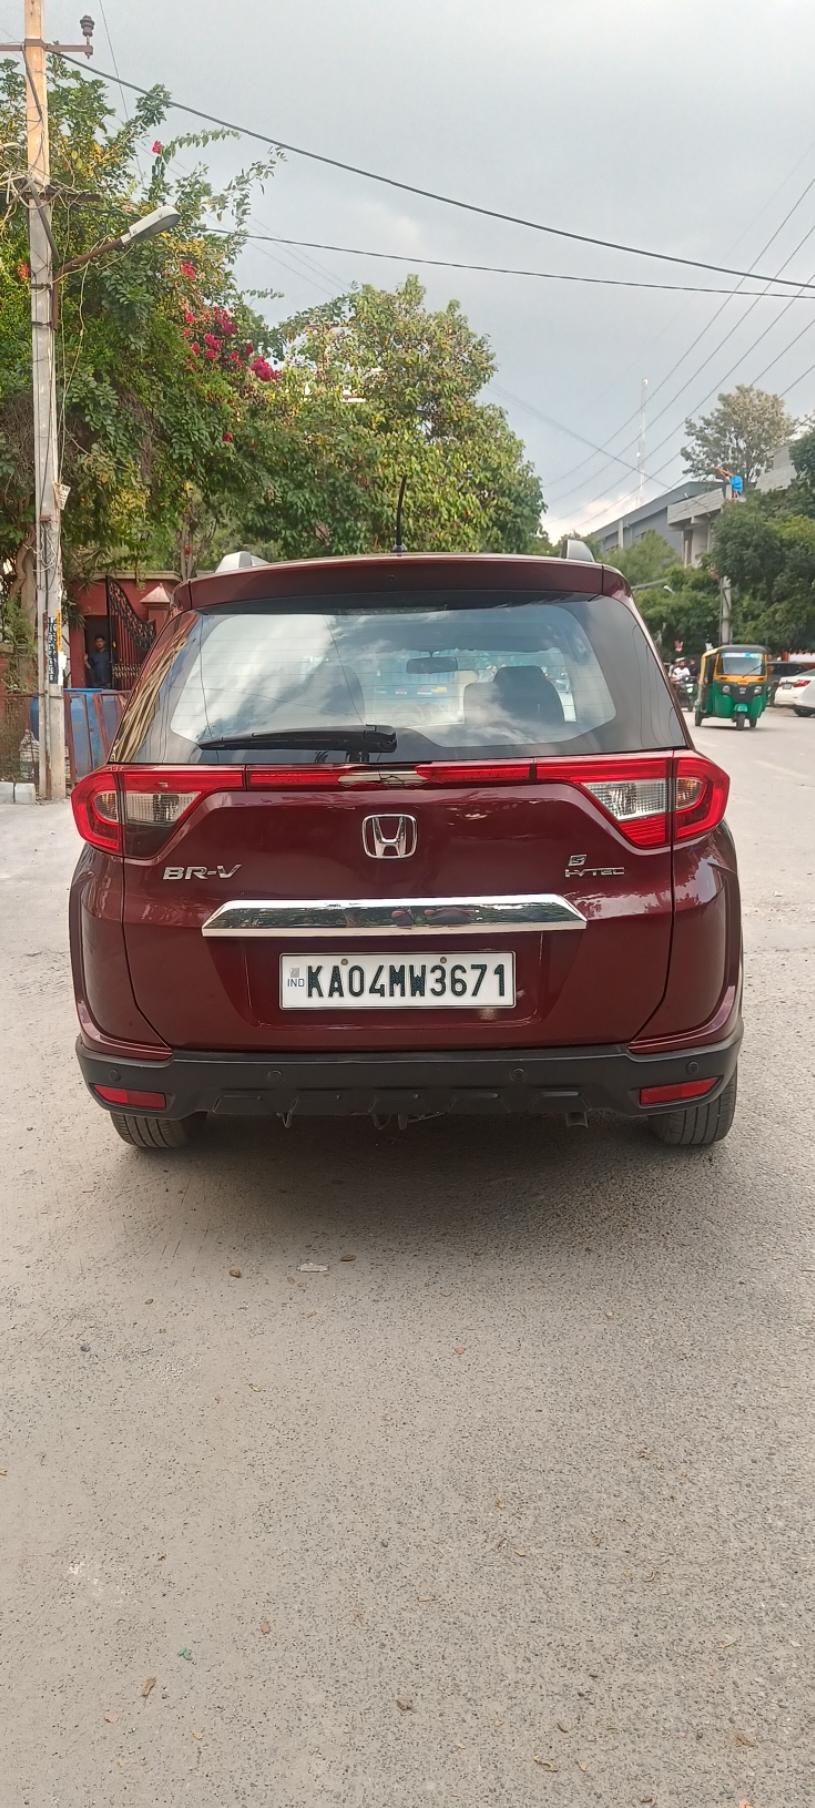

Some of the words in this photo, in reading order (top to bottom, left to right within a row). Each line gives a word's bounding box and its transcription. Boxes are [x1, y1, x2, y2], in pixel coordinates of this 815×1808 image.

[162, 864, 242, 880] BR-V
[287, 978, 305, 988] IND
[306, 963, 505, 998] KA04MW3671
